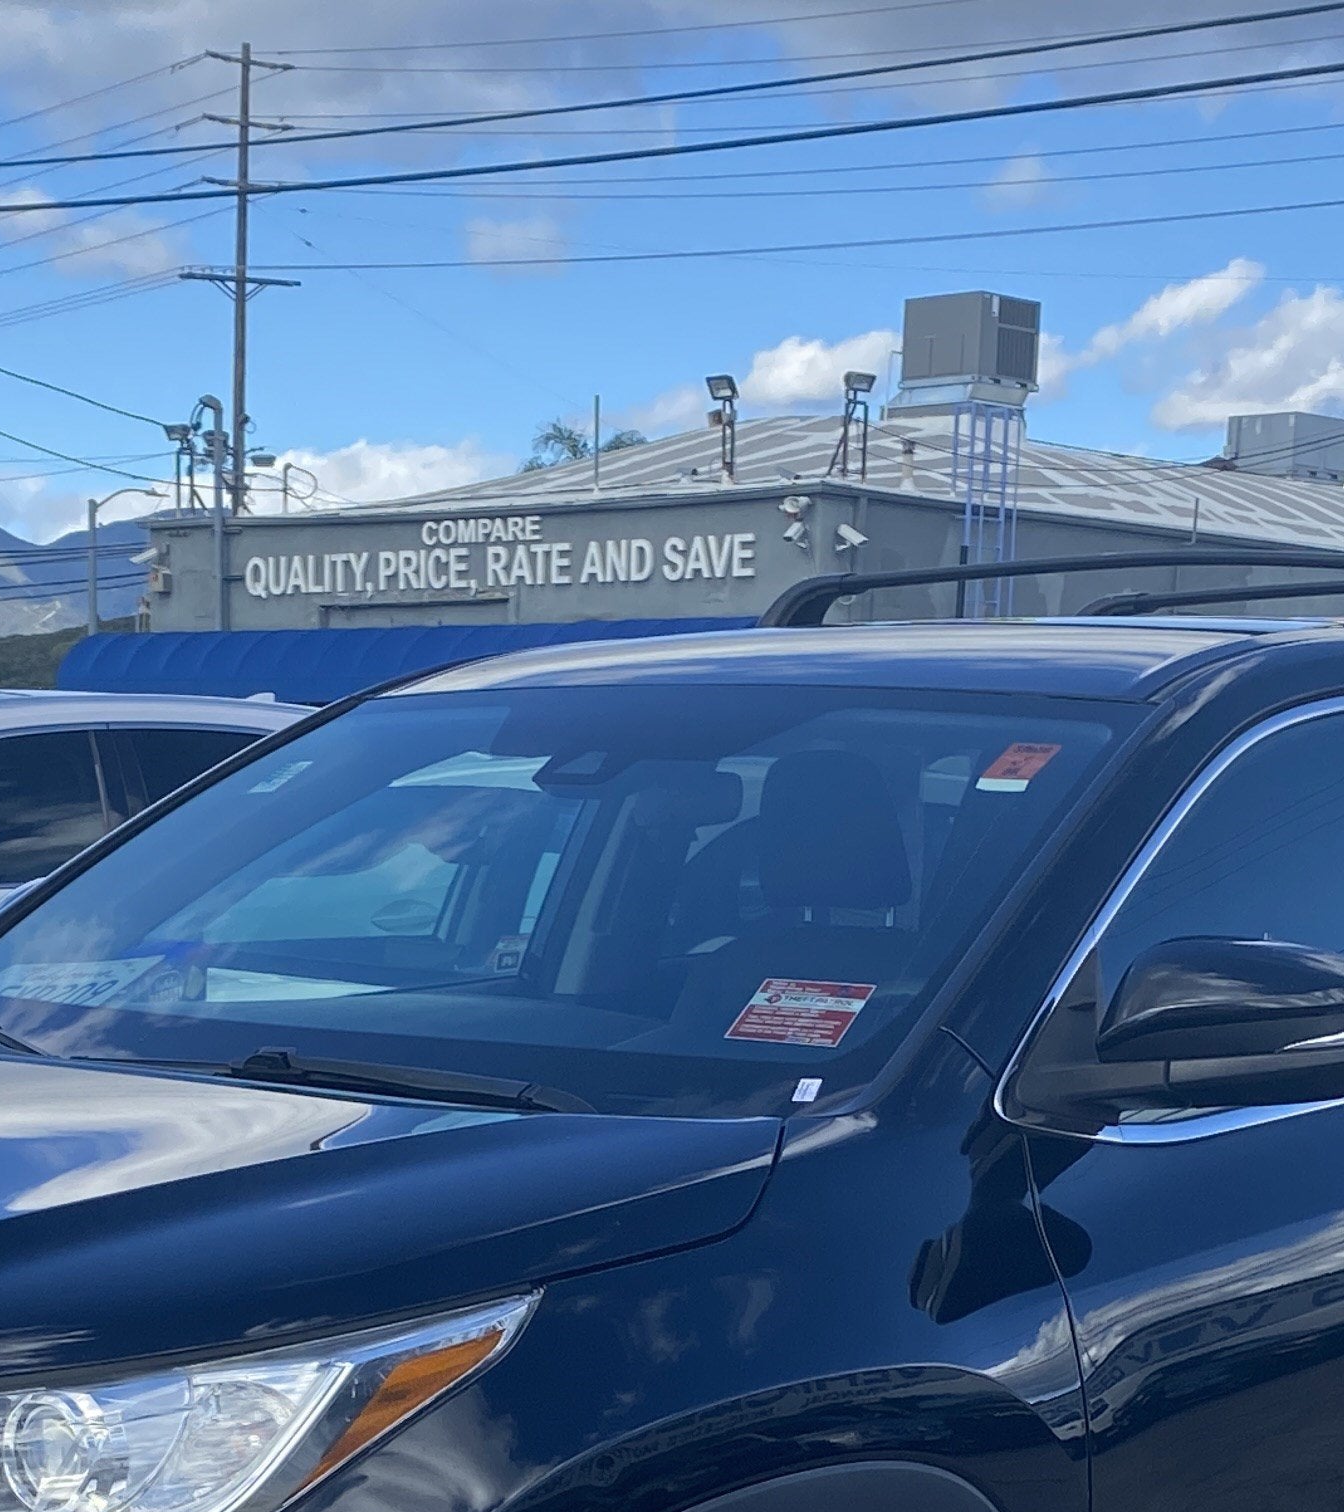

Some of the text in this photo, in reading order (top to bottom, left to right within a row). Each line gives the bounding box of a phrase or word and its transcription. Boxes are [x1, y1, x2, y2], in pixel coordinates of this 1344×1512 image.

[421, 516, 543, 545] COMPARE
[245, 532, 756, 599] QUALITY, PRICE, RATE AND SAVE
